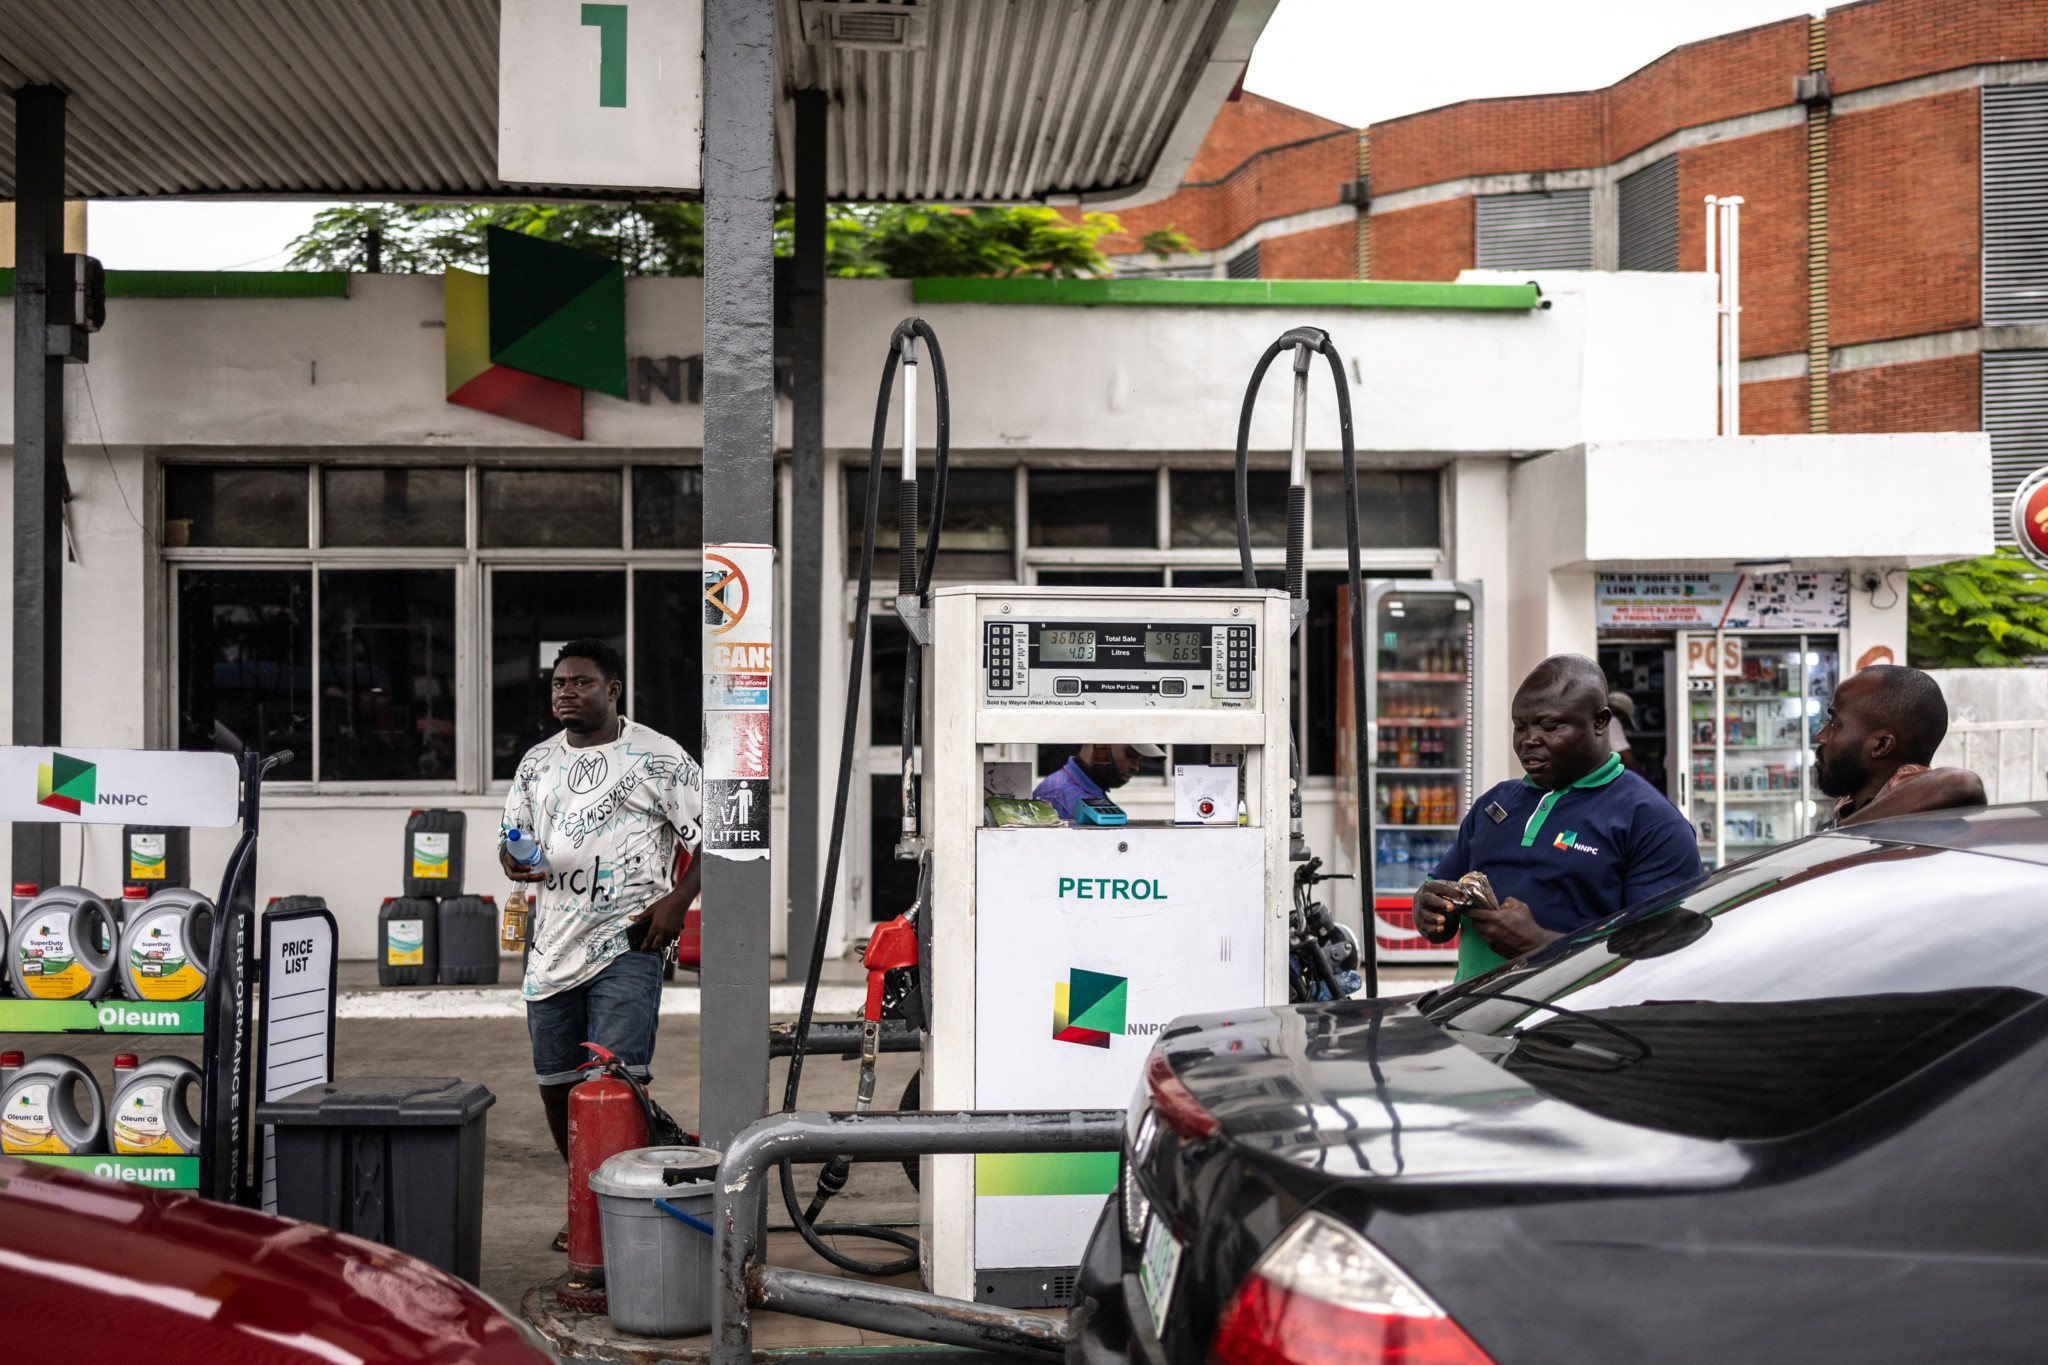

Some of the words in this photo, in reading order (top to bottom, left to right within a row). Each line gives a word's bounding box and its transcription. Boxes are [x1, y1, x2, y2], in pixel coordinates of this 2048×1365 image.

[580, 3, 628, 108] 1
[1684, 574, 1710, 583] HERE
[1606, 585, 1636, 595] LINK
[1642, 585, 1680, 595] JOE'S
[1050, 631, 1095, 645] 3606.8
[1105, 635, 1121, 643] Total
[1122, 635, 1137, 643] Sale
[1156, 633, 1199, 646] 5951.8
[1069, 646, 1095, 660] 4.03
[1172, 648, 1198, 660] 6.65
[99, 794, 148, 806] NNPC
[712, 830, 760, 842] LITTER
[1574, 842, 1598, 855] NNPC
[1059, 877, 1168, 900] PETROL
[282, 939, 313, 958] PRICE
[285, 957, 309, 975] LIST
[99, 1007, 181, 1027] Oleum
[231, 914, 245, 1110] PERFORMANCE
[231, 1119, 239, 1142] IN
[95, 1163, 176, 1181] Oleum
